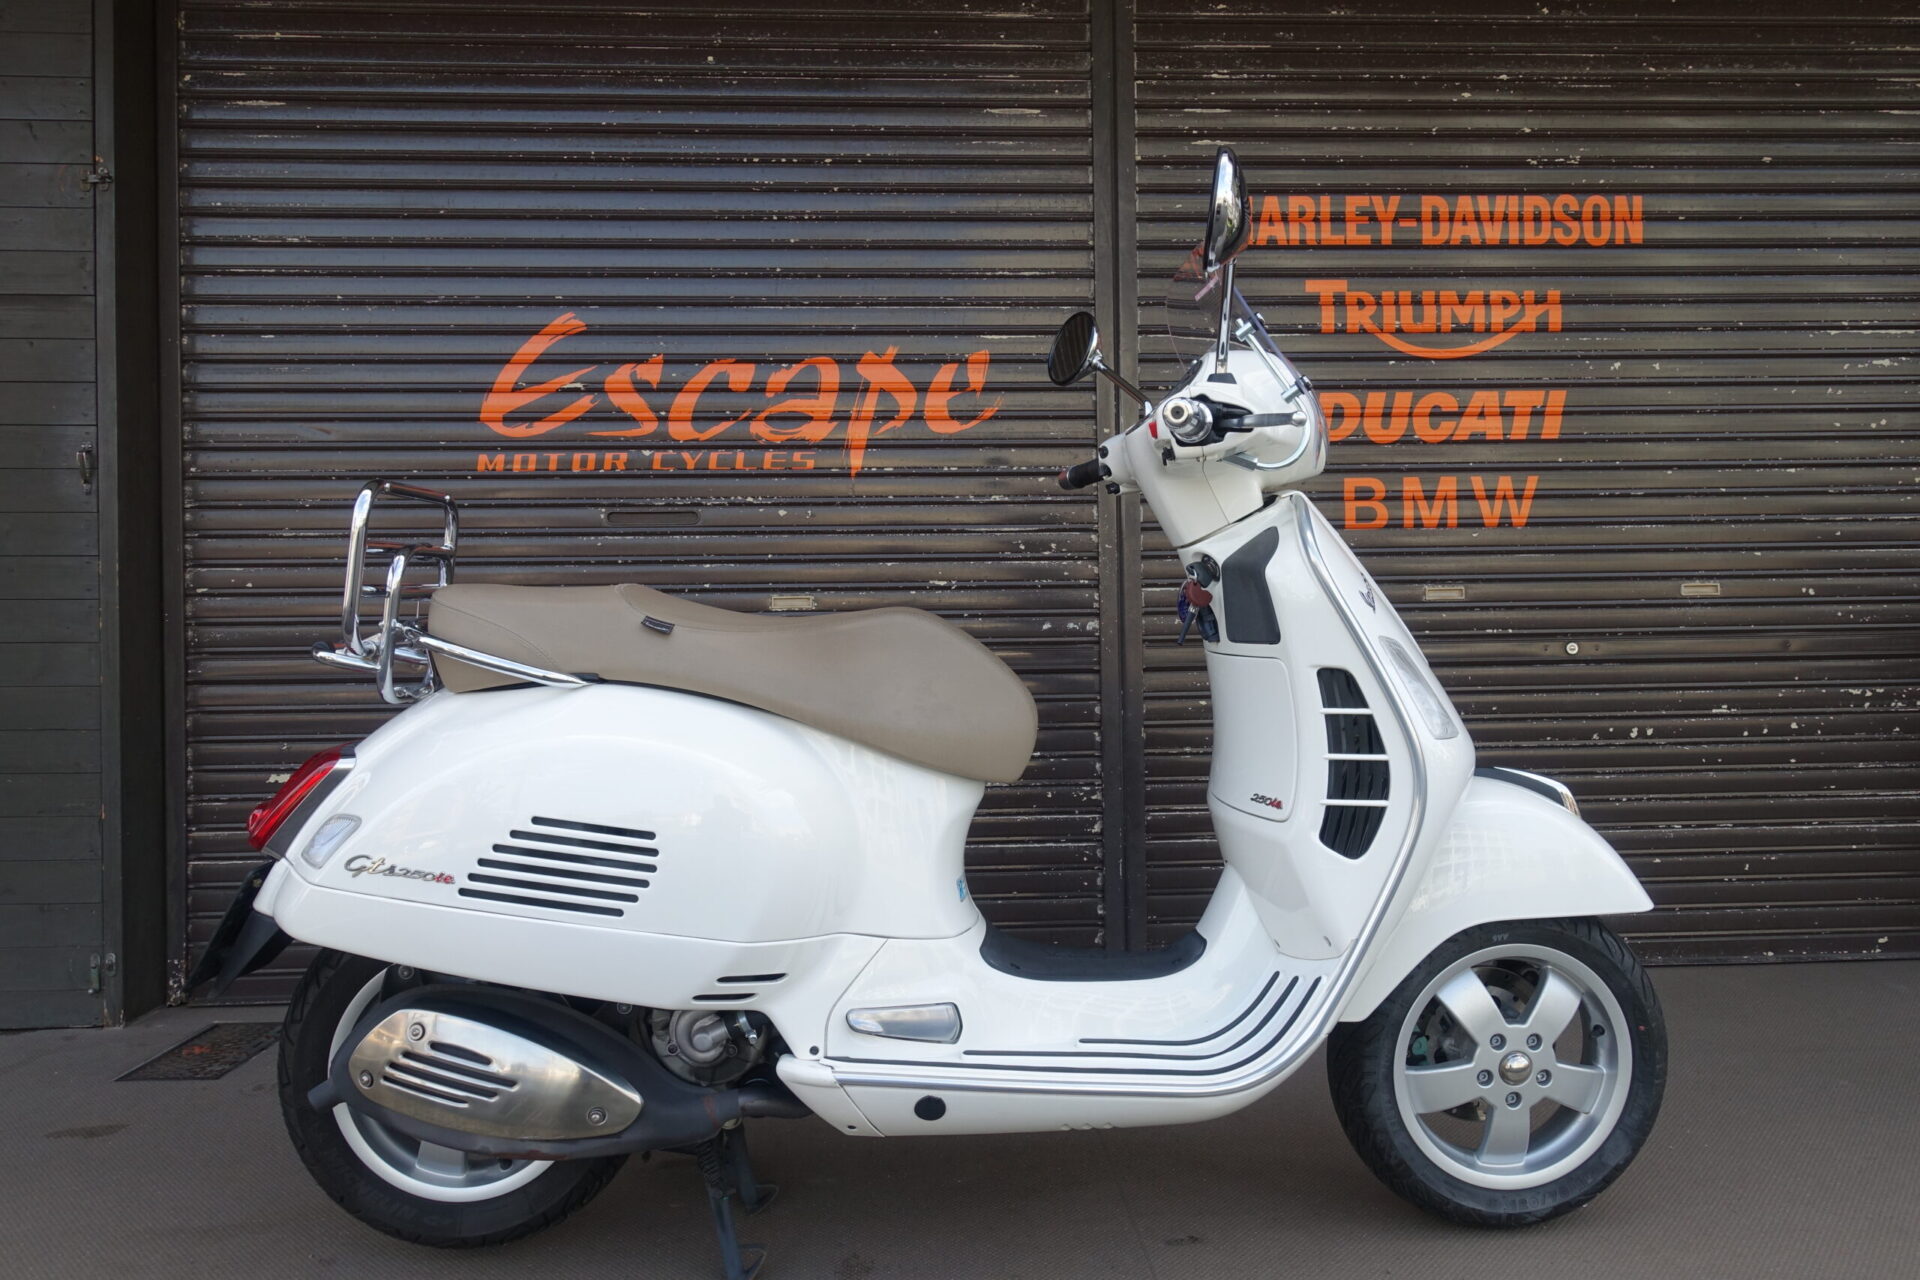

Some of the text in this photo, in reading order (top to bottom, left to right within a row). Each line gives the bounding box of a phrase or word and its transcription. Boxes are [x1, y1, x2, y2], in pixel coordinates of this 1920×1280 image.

[1247, 194, 1644, 246] ARLEY-DAVIDSON
[1304, 280, 1563, 359] TRIUMPH
[479, 312, 1003, 478] Escape
[1322, 390, 1568, 444] DUCATI
[476, 452, 816, 472] MOTOR CYCLES
[1343, 475, 1540, 530] BMW
